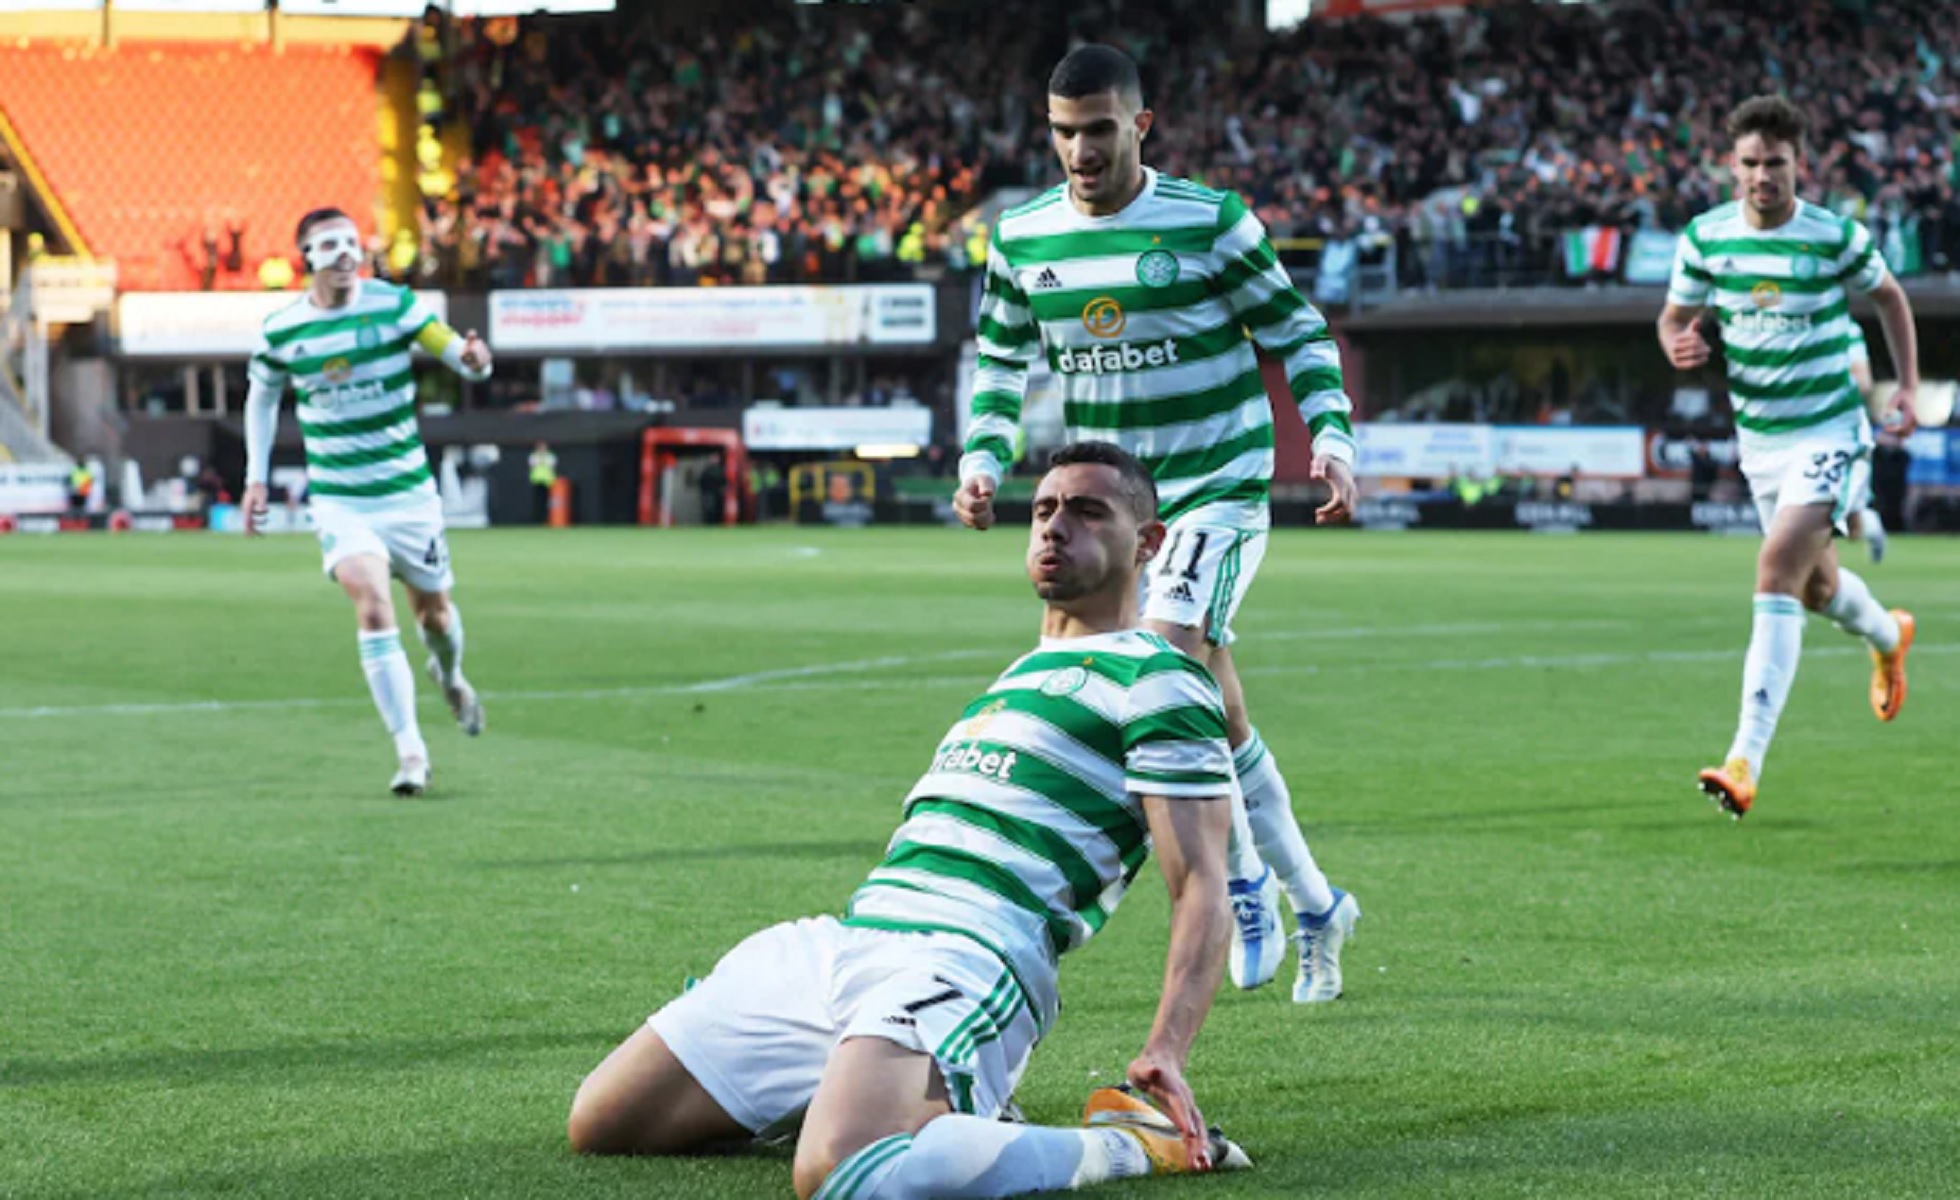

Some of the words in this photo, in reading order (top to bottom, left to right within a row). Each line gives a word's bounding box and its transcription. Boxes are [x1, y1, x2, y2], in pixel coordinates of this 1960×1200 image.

[1058, 338, 1179, 376] dafabet
[1803, 450, 1851, 483] 33
[1160, 528, 1209, 581] 11
[902, 974, 964, 1015] 7
